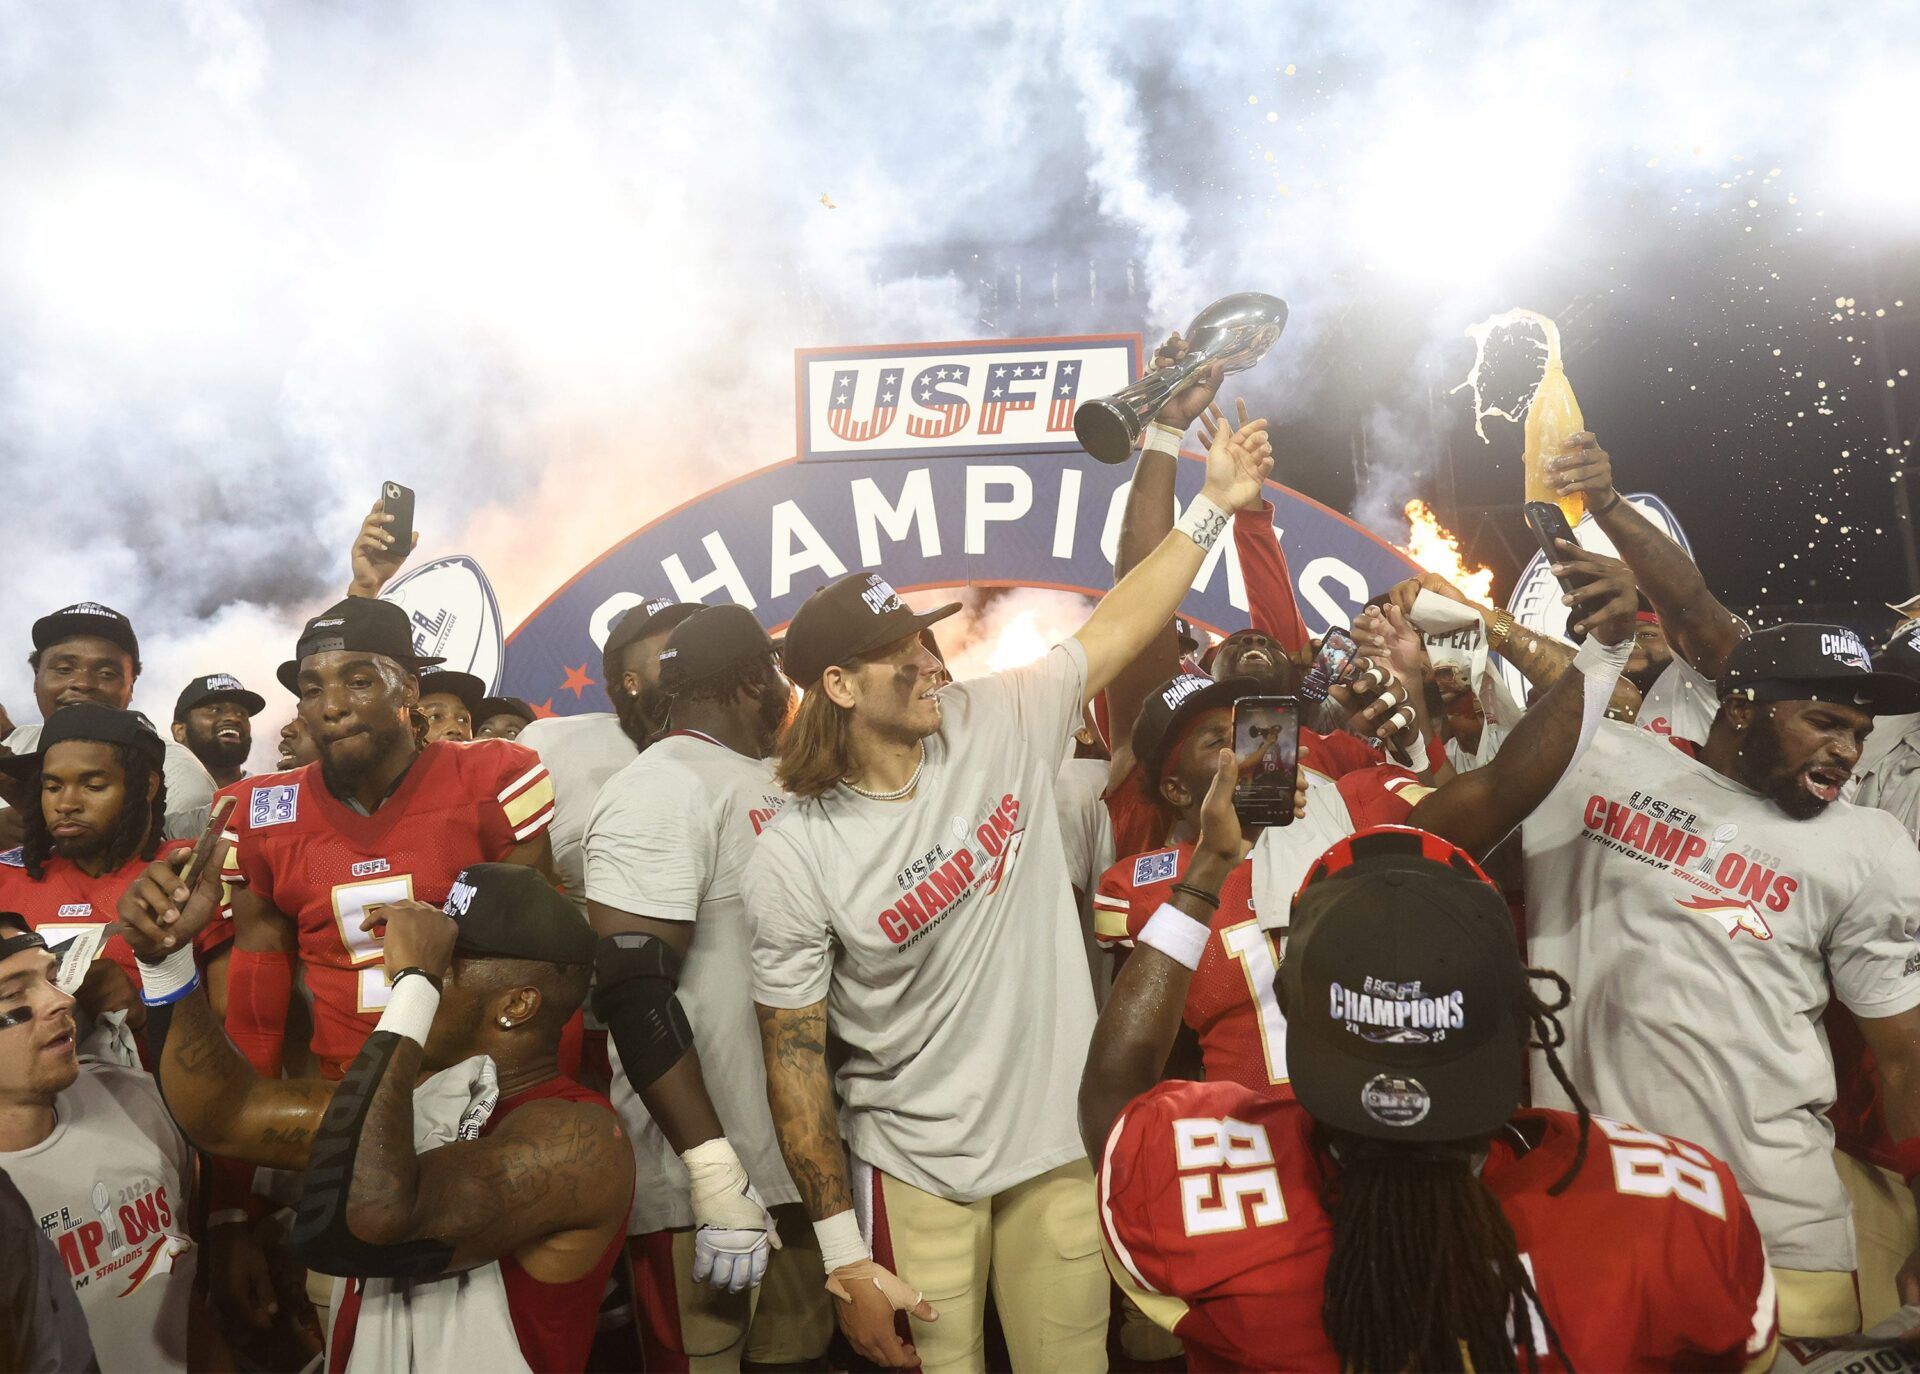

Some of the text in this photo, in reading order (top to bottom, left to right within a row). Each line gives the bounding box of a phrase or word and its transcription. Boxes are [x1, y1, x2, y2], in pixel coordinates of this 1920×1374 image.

[1195, 508, 1228, 535] 38
[1629, 790, 1701, 835] USFL
[353, 860, 389, 875] USFL
[896, 843, 954, 891] USFL
[1581, 829, 1723, 896] BIRMINGHAM STALLIONS
[1742, 844, 1782, 869] 2023
[59, 904, 92, 916] USFL
[898, 888, 971, 953] BIRMINGHAM
[1330, 982, 1464, 1029] CHAMPIONS
[1345, 1020, 1447, 1043] 20 23
[118, 1178, 151, 1204] 2023
[1172, 1115, 1289, 1238] 85
[40, 1206, 83, 1238] FL
[95, 1247, 143, 1281] STALLIONS
